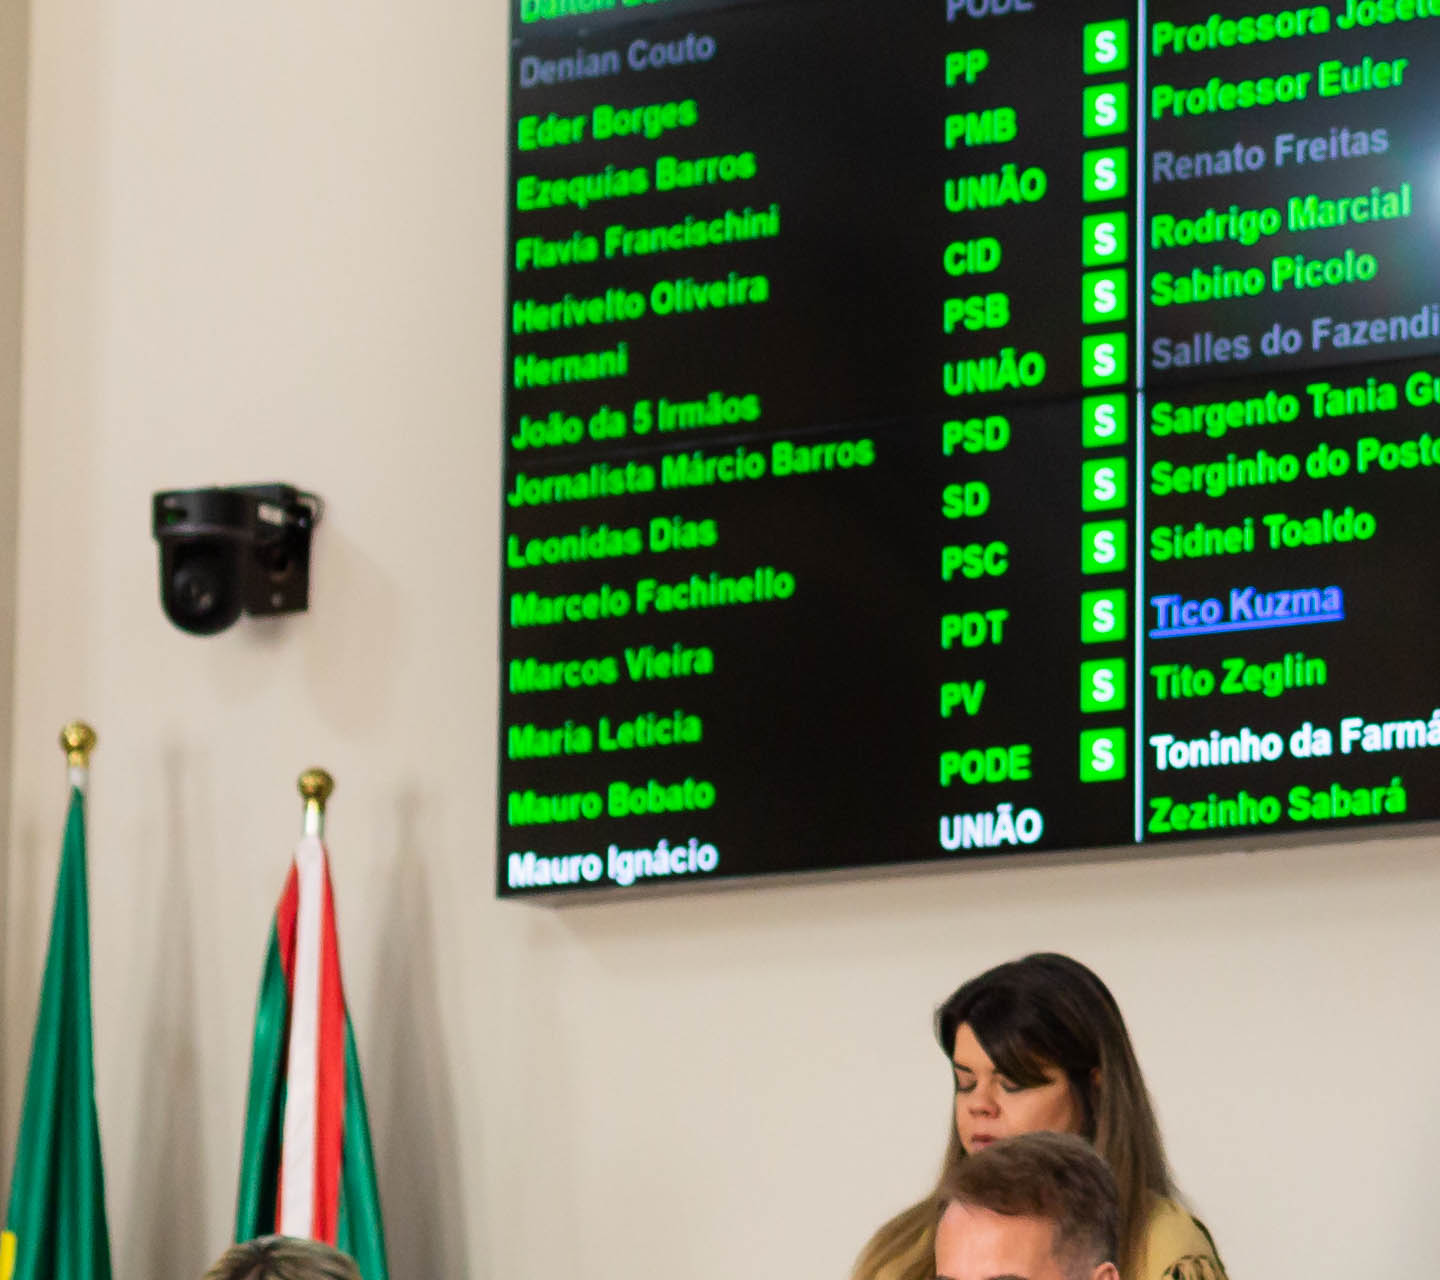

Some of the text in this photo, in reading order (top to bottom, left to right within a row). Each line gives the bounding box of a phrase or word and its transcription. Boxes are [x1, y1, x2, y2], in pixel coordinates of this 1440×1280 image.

[1151, 5, 1331, 56] Professora
[517, 99, 697, 151] Eder Borges
[516, 151, 757, 211] Ezequias Barros
[515, 204, 780, 271] Flavia Francischini
[1151, 248, 1378, 307] Sabino Picolo
[513, 343, 628, 388] Hernani
[1150, 506, 1377, 561] Sidnei Toaldo
[1148, 585, 1345, 628] Tico Kuzma
[509, 644, 714, 693] Marcos Vieira
[1149, 652, 1327, 700] Tito Zeglin
[1148, 732, 1285, 771] Toninho
[1288, 721, 1333, 759] da
[507, 837, 719, 888] Mauro Ignácio
